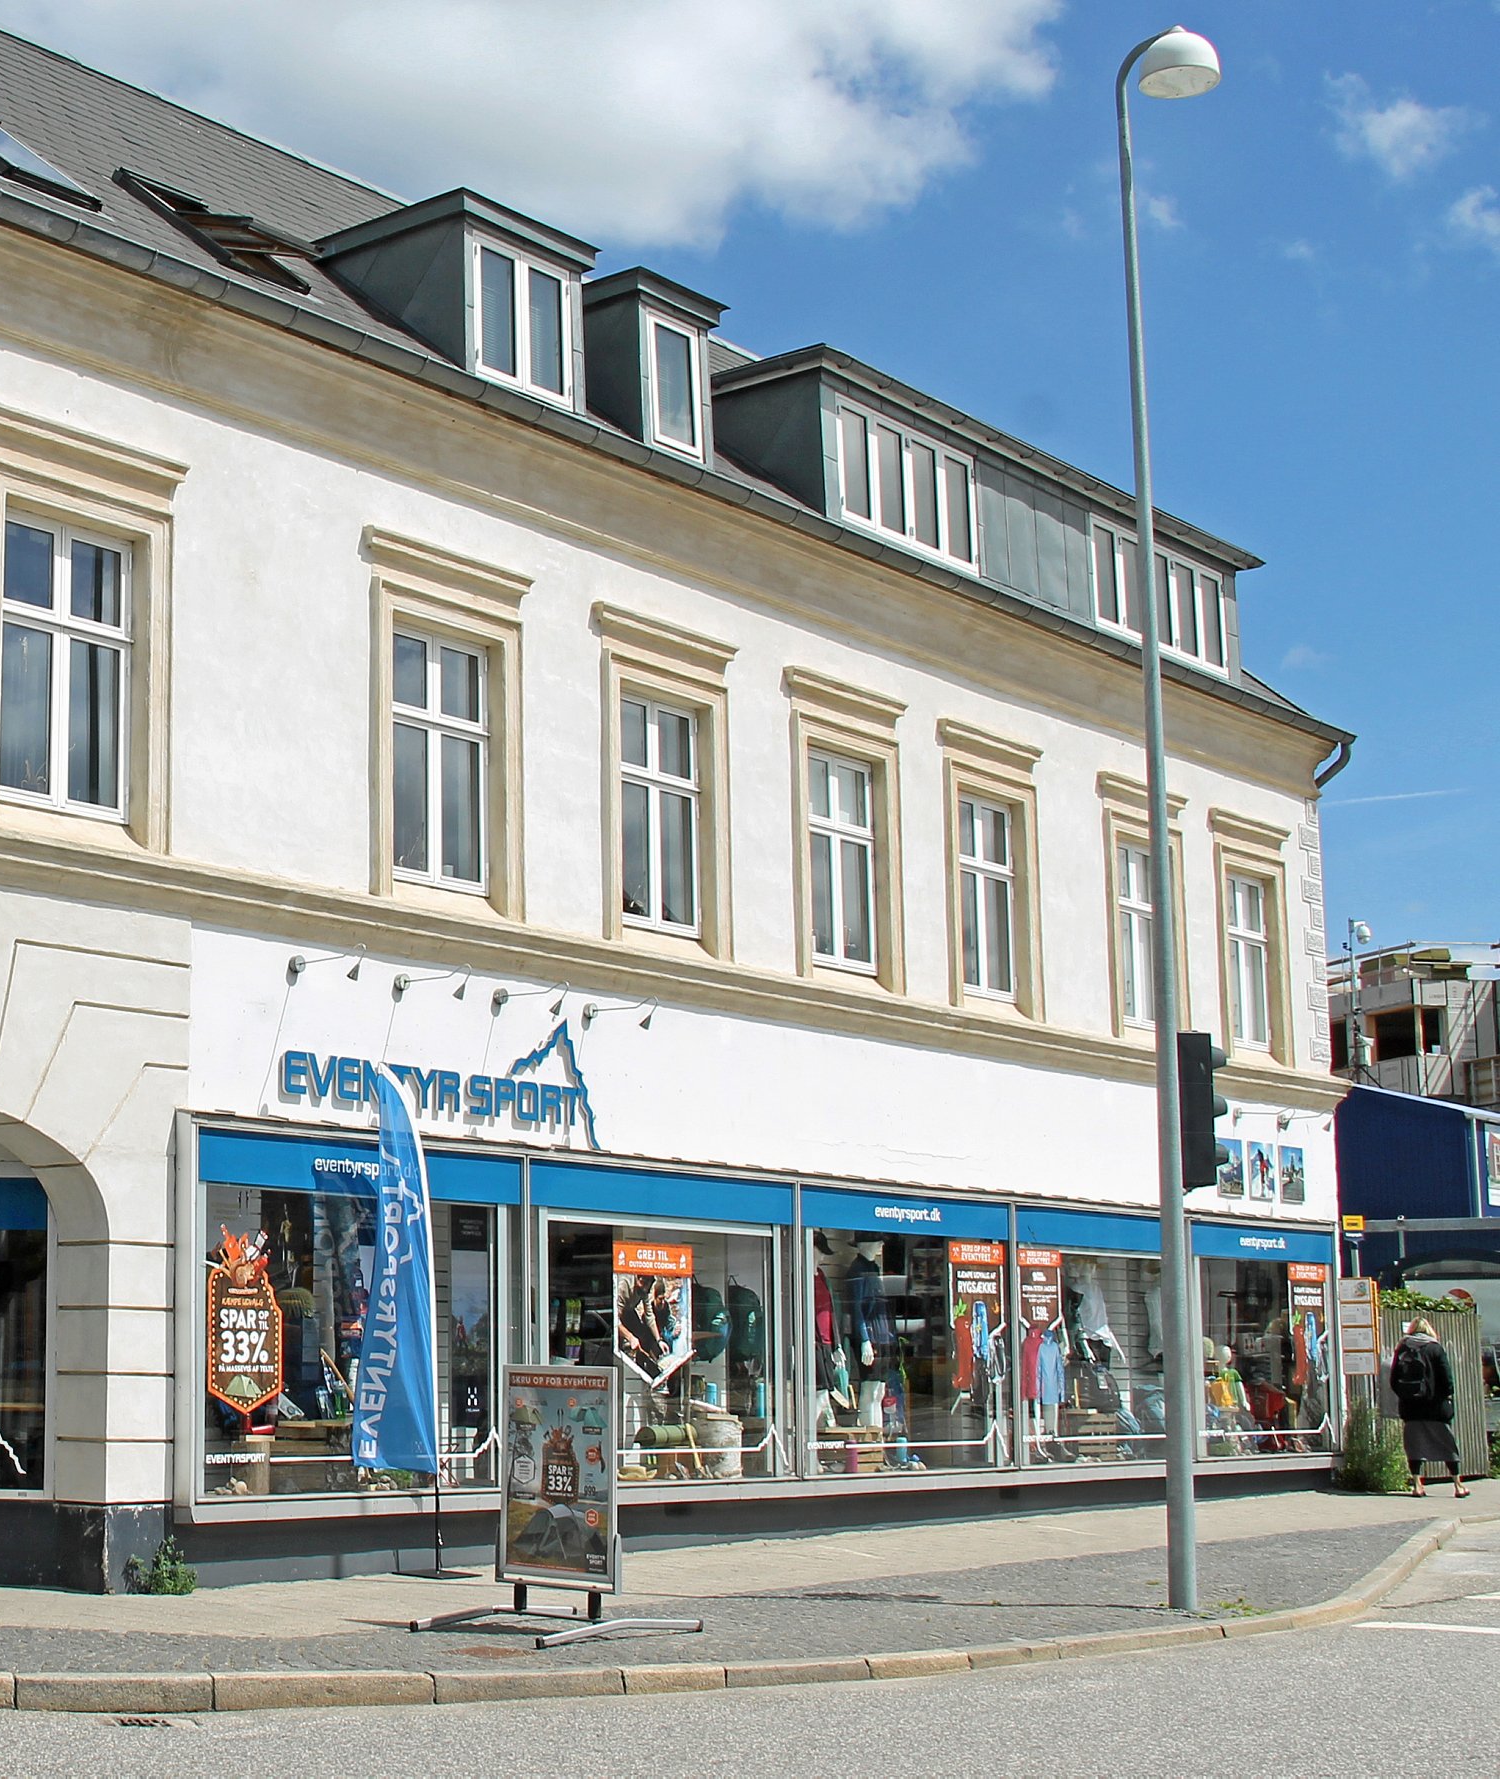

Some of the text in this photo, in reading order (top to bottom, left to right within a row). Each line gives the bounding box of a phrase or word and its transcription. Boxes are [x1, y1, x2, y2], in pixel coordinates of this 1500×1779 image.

[284, 1050, 581, 1126] EVENTYR SPORT
[874, 1206, 941, 1223] eventyrsport.dk
[636, 1249, 669, 1261] GREJ TIL
[628, 1260, 677, 1270] OUTDOOR COOKING
[957, 1280, 997, 1294] RYGSÆKKE
[220, 1308, 270, 1329] SPAR OP
[258, 1320, 270, 1330] TIL
[220, 1330, 269, 1363] 33%
[218, 1363, 226, 1372] PÅ
[226, 1364, 252, 1373] MASSEVIS
[260, 1365, 274, 1373] TELTE
[532, 1376, 544, 1385] OP
[545, 1376, 562, 1386] FOR
[563, 1376, 606, 1388] EVENTYRET
[205, 1453, 266, 1464] EVENTYRSPORT
[548, 1464, 567, 1475] SPAR
[548, 1475, 572, 1491] 33%
